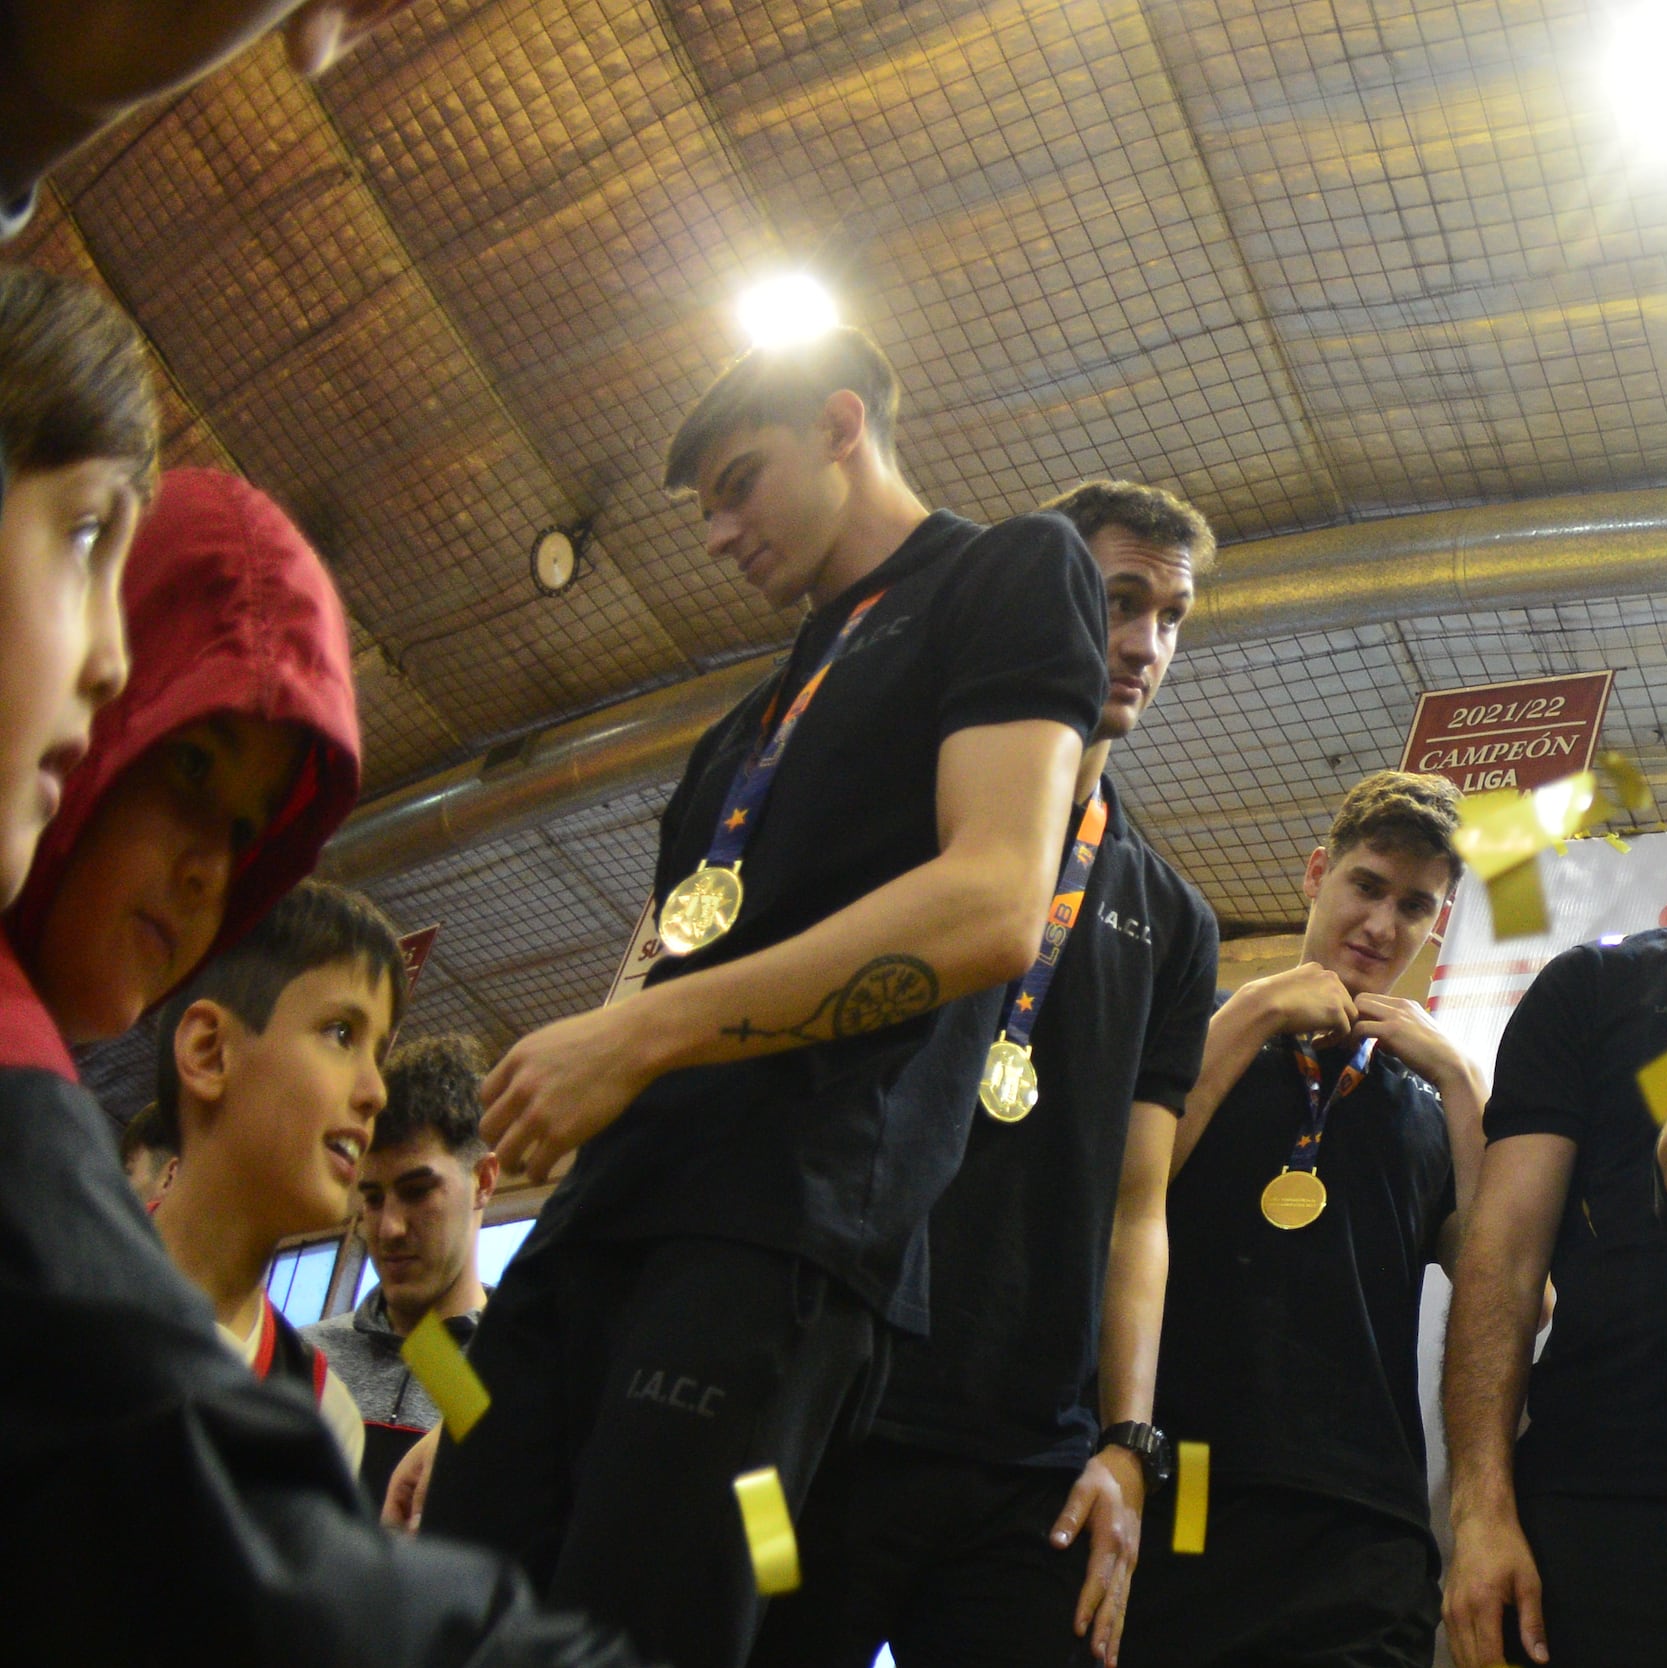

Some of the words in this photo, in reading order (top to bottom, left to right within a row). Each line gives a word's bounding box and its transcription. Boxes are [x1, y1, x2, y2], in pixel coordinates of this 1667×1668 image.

[1447, 696, 1566, 729] 2021/22
[1419, 732, 1580, 771] CAMPEÓN
[1463, 769, 1517, 792] LIGA
[1037, 901, 1073, 967] LSB
